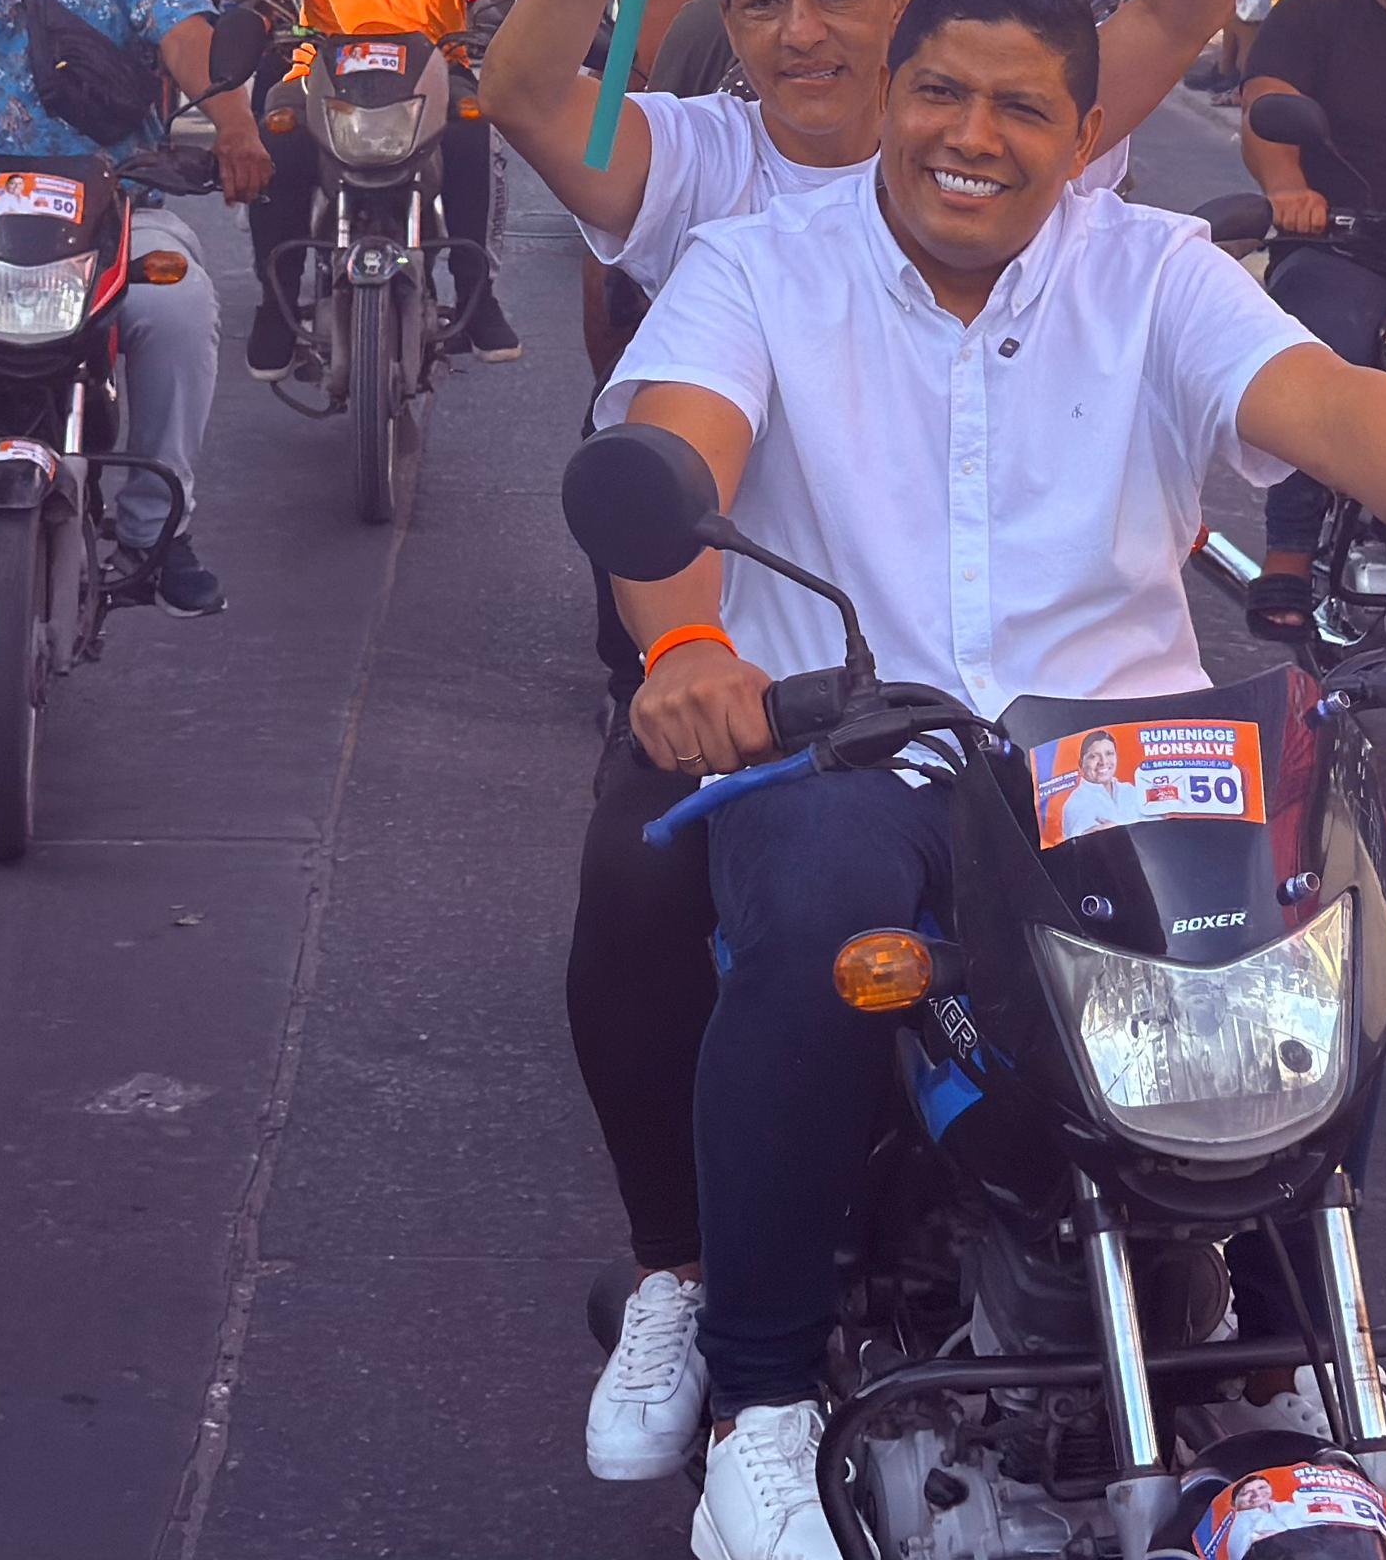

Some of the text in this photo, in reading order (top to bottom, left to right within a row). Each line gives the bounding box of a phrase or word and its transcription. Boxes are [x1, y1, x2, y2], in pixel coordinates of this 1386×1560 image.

[53, 198, 74, 213] 50
[1140, 727, 1236, 743] RUMENIGGE
[1144, 742, 1234, 757] MONSALVE
[1189, 775, 1238, 805] 50
[1172, 912, 1246, 935] BOXER
